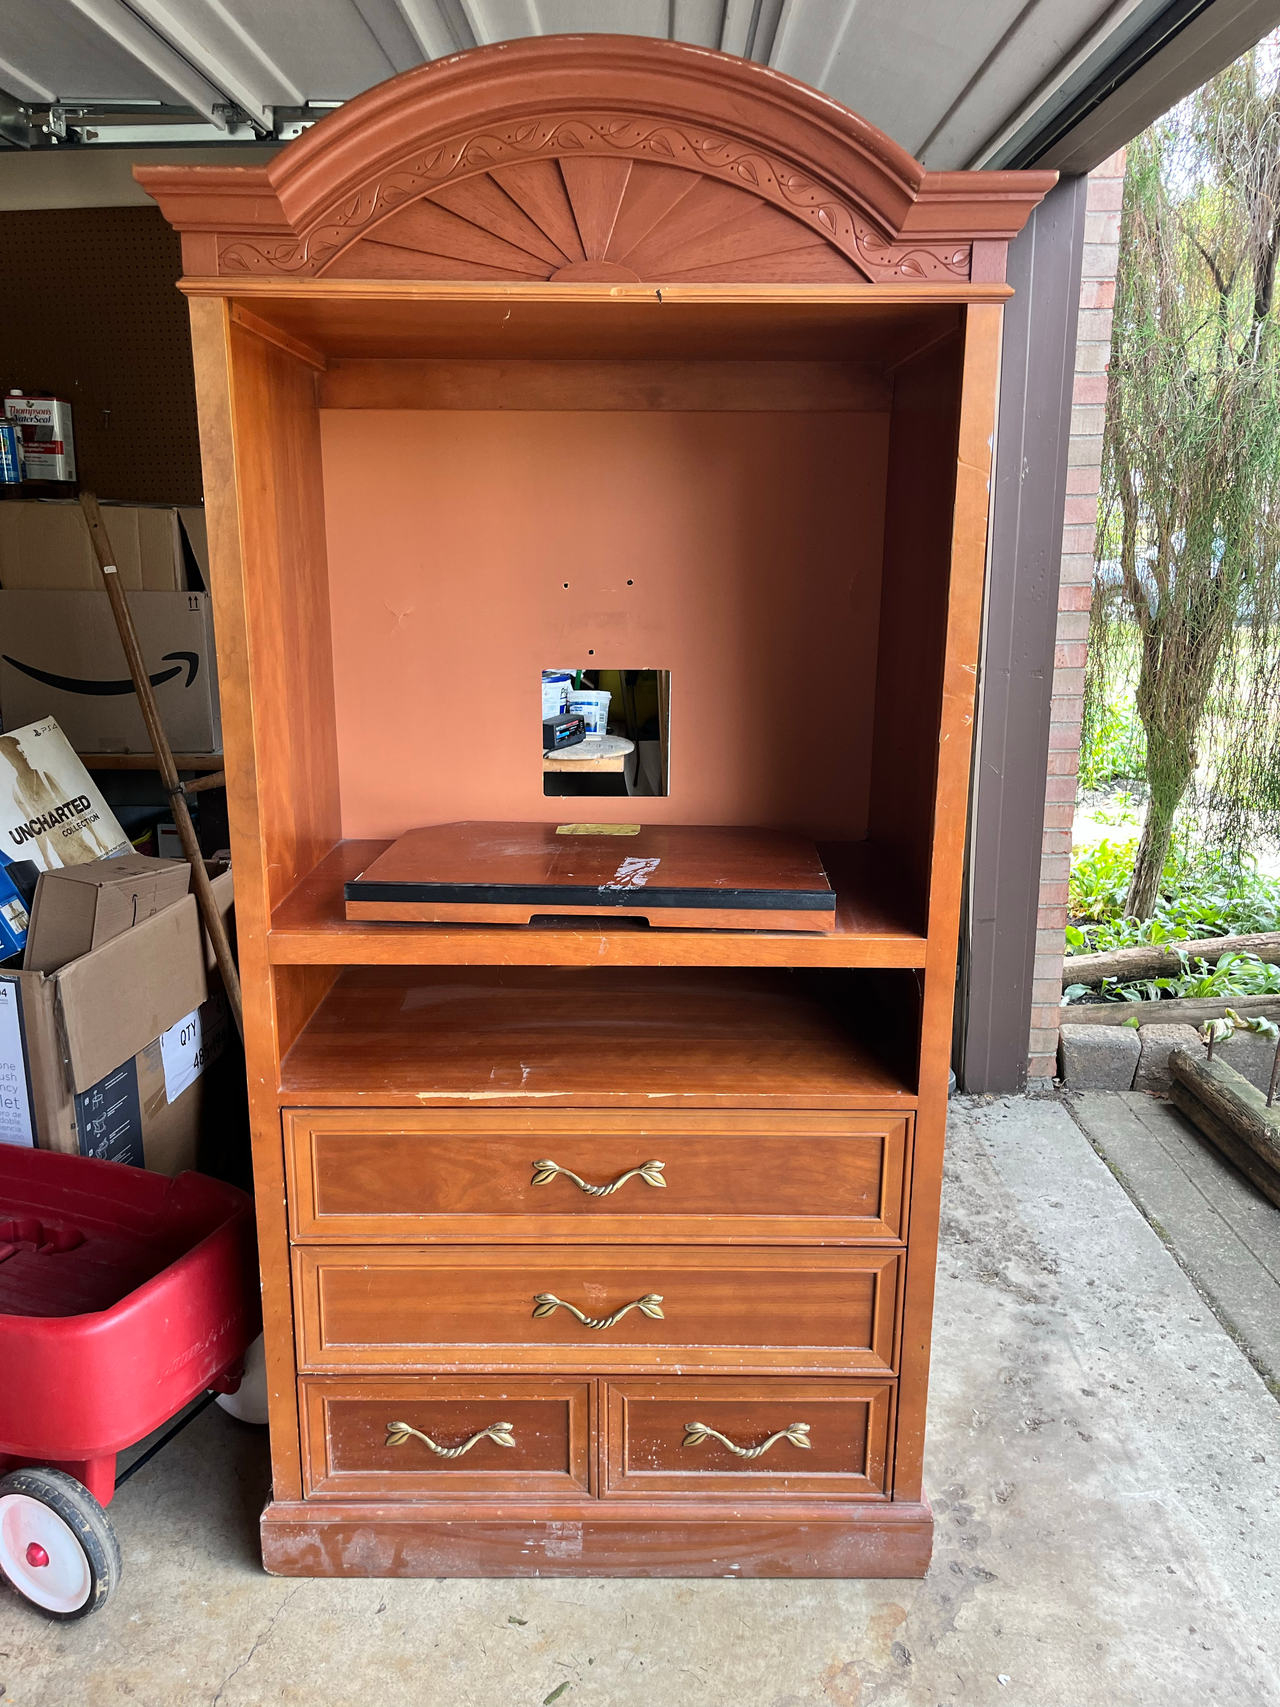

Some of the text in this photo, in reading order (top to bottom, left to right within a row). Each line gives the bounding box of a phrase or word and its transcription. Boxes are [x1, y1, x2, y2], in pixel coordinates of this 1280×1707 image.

[41, 723, 58, 734] PS4
[9, 794, 91, 845] UNCHARTED
[62, 812, 100, 837] COLLECTION
[180, 1019, 196, 1047] QTY
